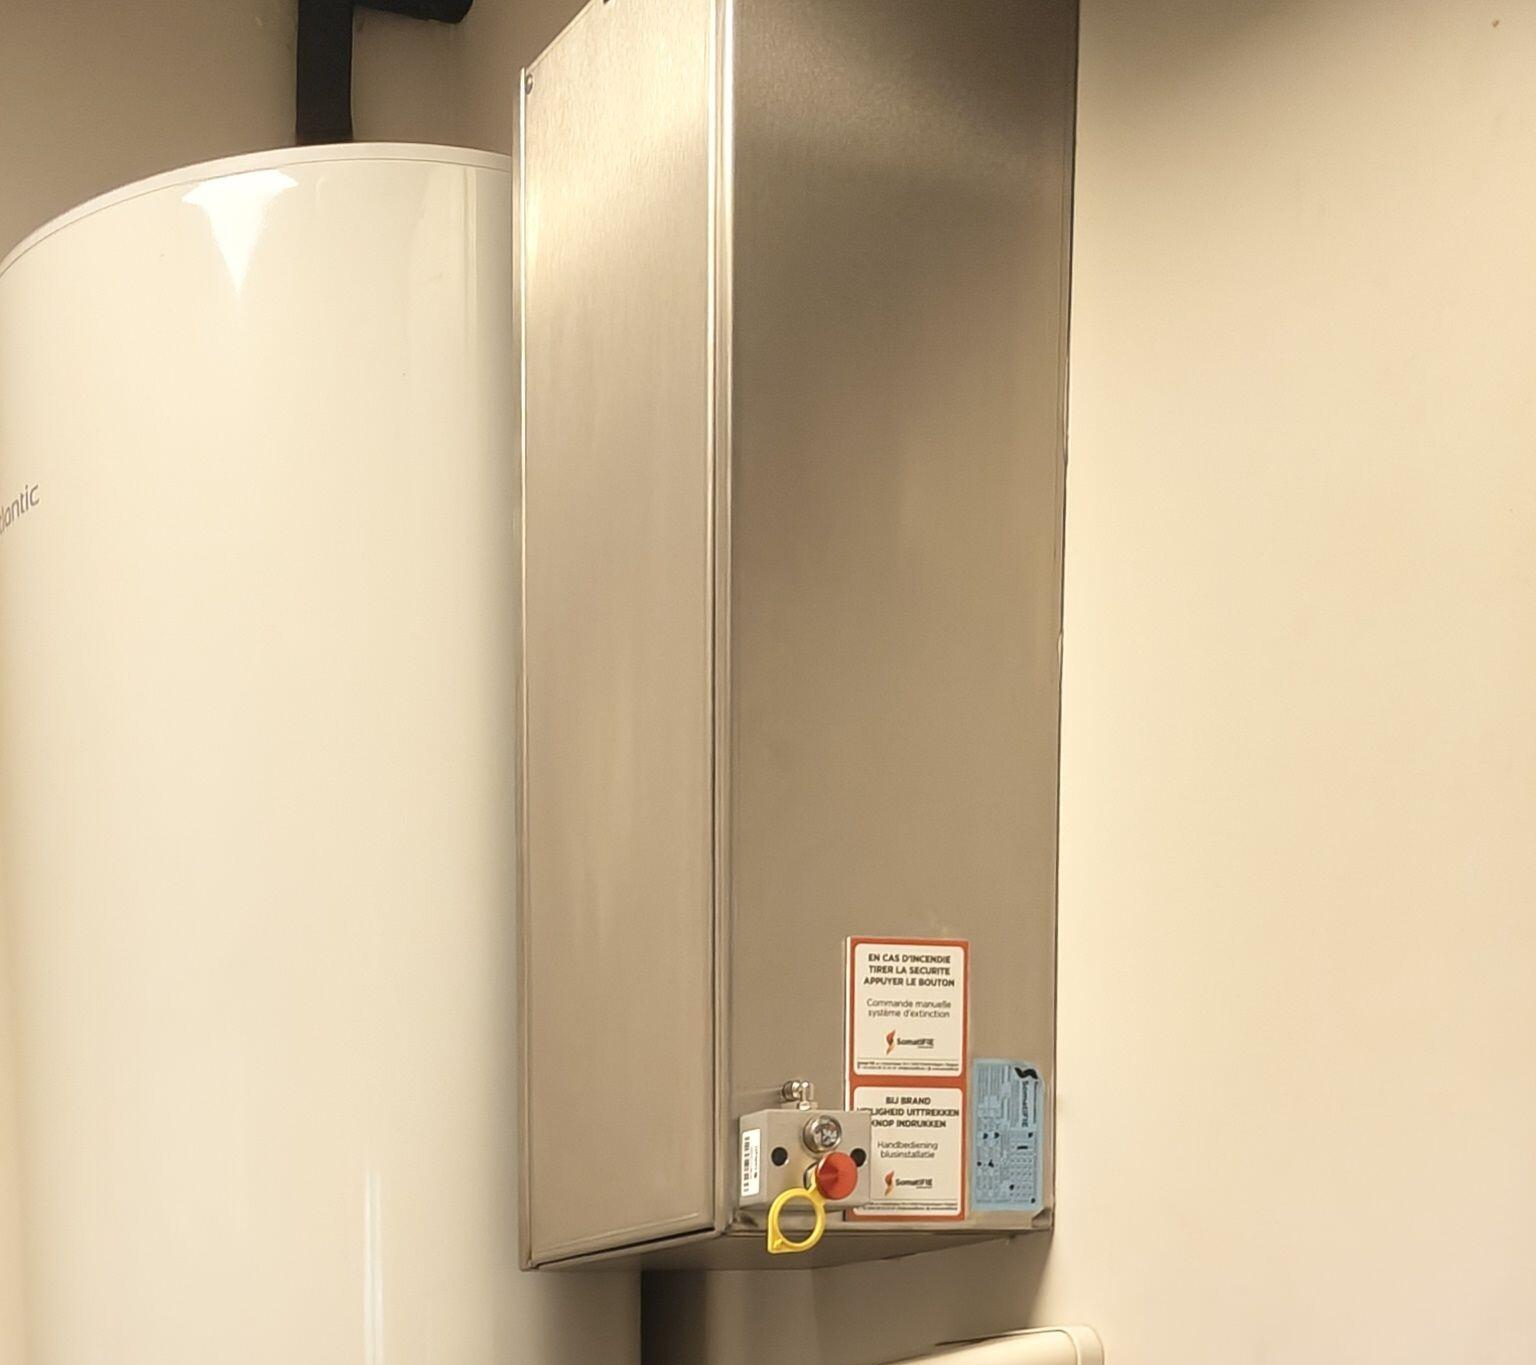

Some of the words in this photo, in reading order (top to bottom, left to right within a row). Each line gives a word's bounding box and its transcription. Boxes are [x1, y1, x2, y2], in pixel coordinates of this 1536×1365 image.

[868, 954, 880, 962] EN
[882, 954, 900, 962] CAS
[902, 955, 951, 964] D'INCENDIE
[869, 965, 894, 974] TIRER
[896, 966, 907, 974] LA
[909, 966, 951, 975] SECURITE
[864, 977, 904, 986] APPUYER
[906, 978, 916, 986] LE
[918, 978, 955, 987] BOUTON
[866, 999, 913, 1008] Commande
[915, 1000, 952, 1008] manuelle
[885, 1096, 899, 1105] BIJ
[901, 1096, 932, 1105] BRAND
[906, 1108, 960, 1117] UITTREKKEN
[896, 1119, 947, 1128] INDRUKKEN
[877, 1141, 939, 1151] Handbediening
